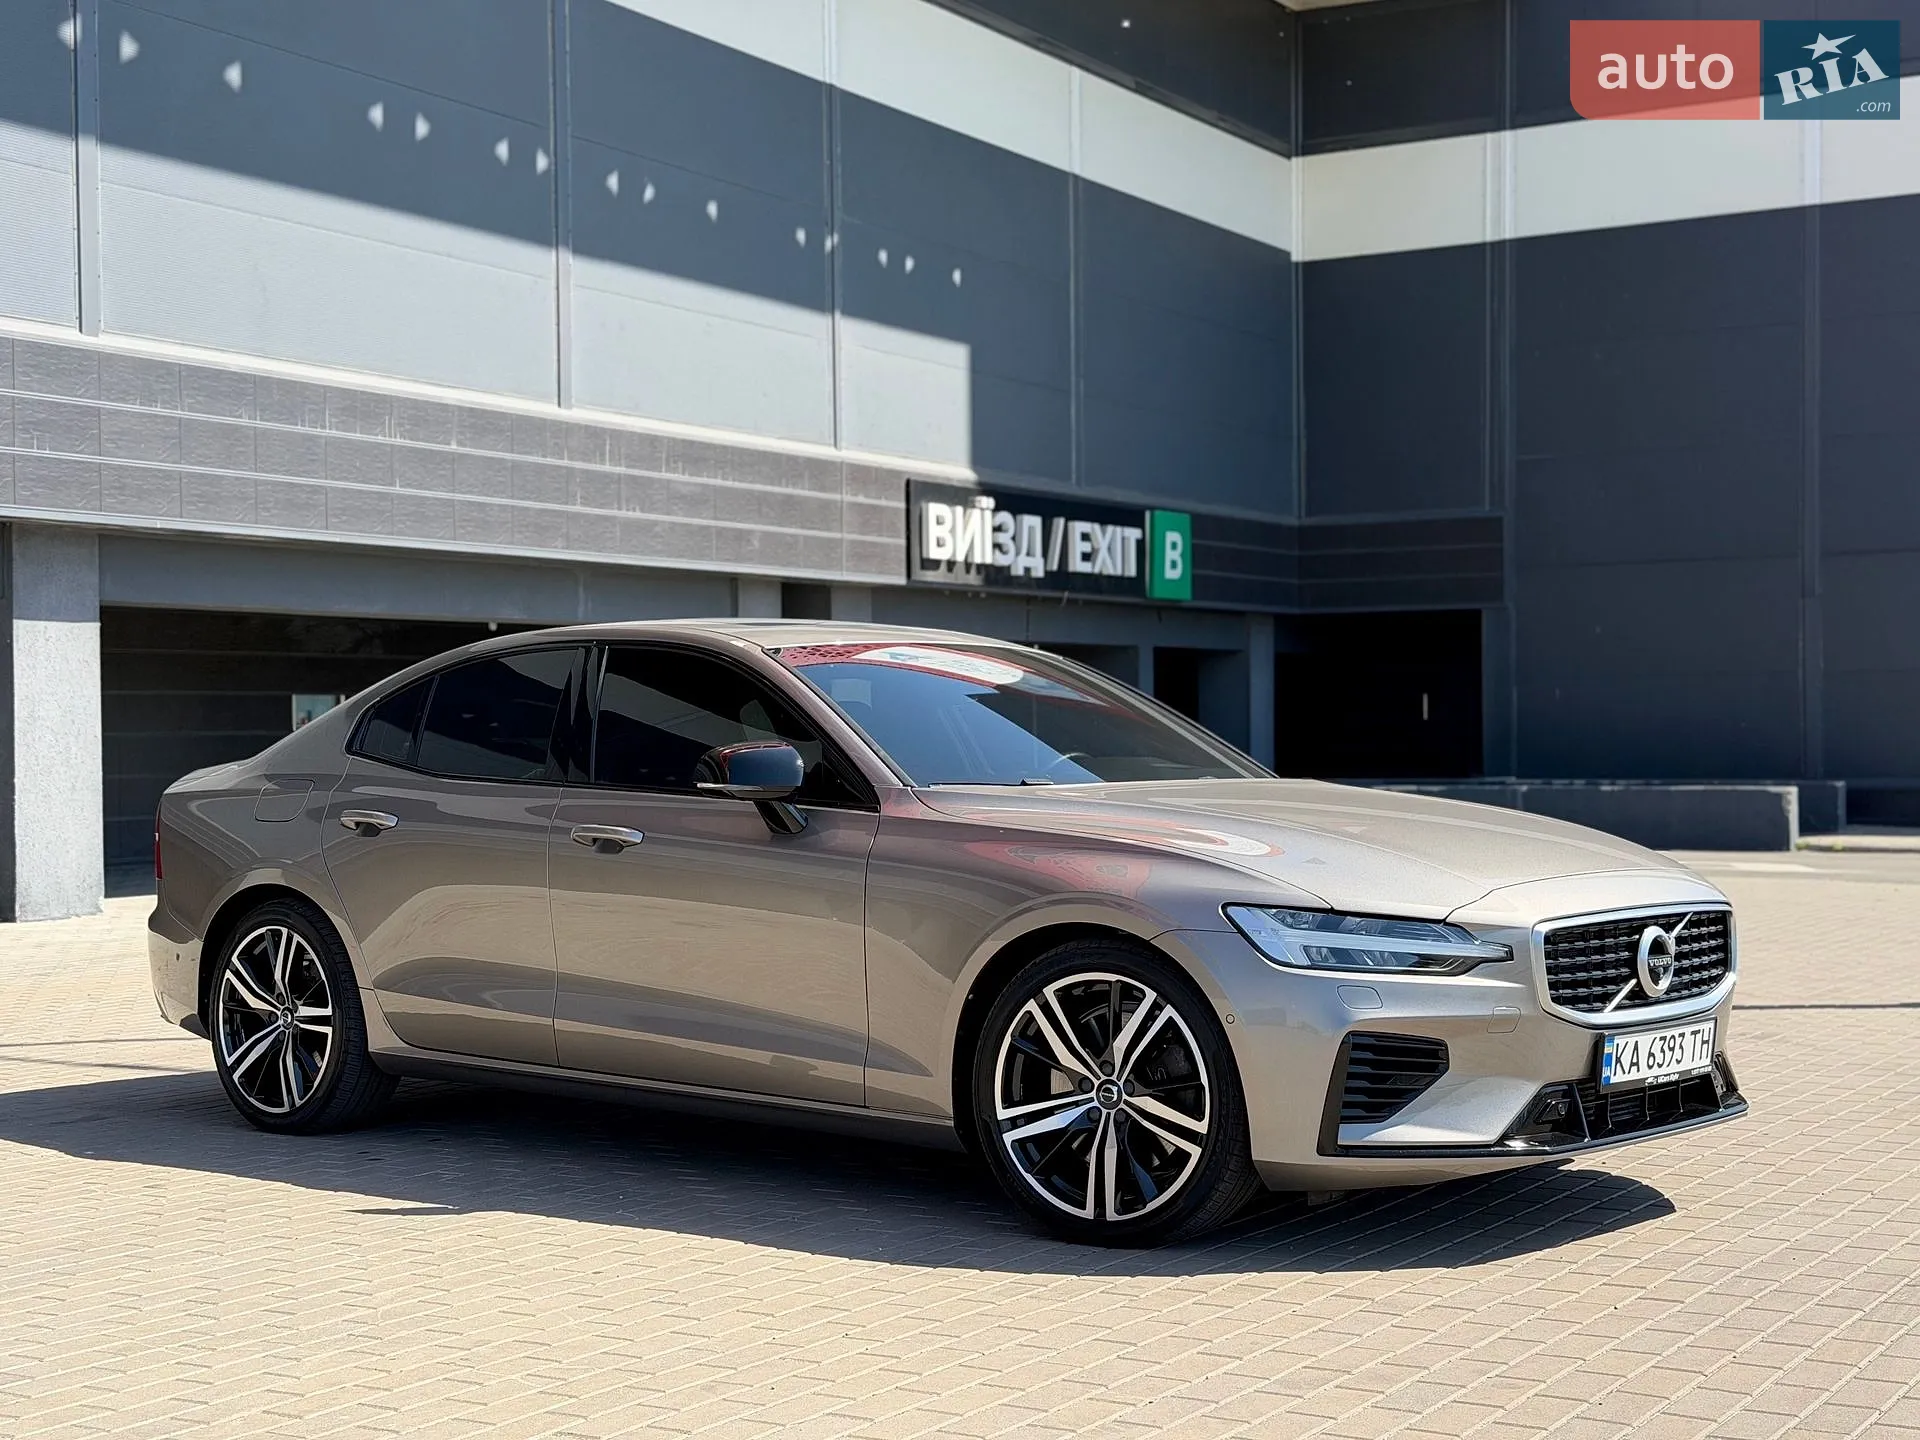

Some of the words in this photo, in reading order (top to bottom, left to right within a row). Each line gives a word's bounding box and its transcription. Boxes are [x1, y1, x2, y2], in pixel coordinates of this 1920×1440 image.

[922, 496, 1045, 578] ВИЇЗД
[1067, 520, 1142, 578] EXIT
[1164, 531, 1183, 580] B
[1648, 957, 1672, 967] VOLVO
[1613, 1040, 1640, 1077] KA
[1646, 1032, 1686, 1070] 6393
[1690, 1027, 1712, 1063] TH
